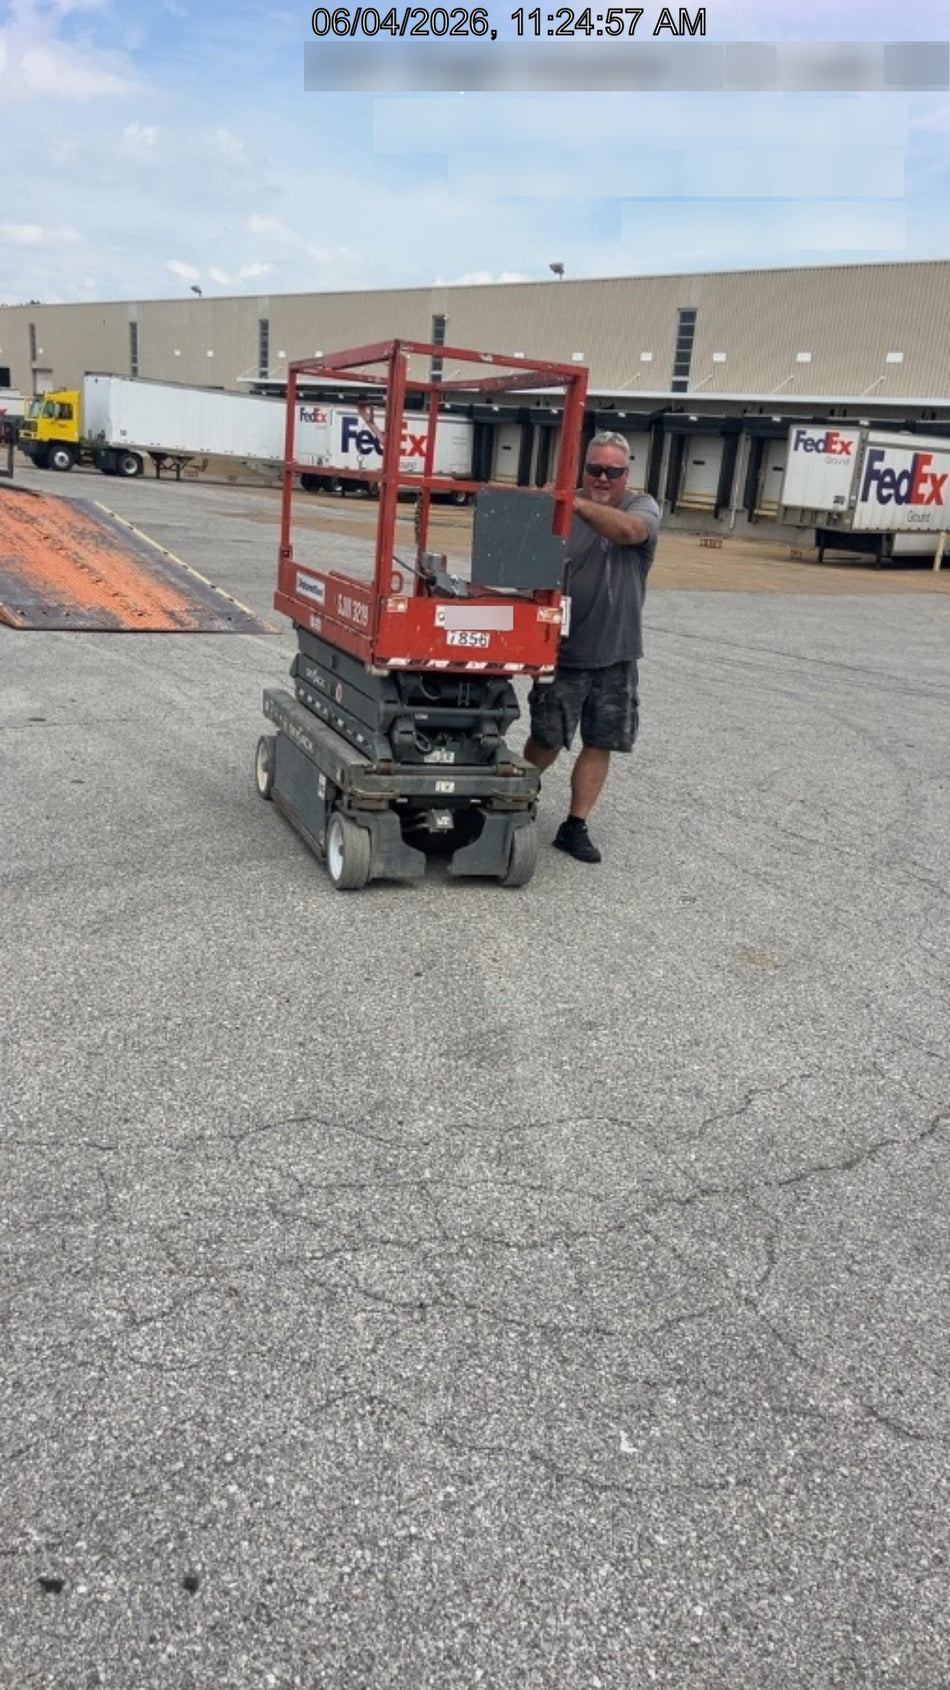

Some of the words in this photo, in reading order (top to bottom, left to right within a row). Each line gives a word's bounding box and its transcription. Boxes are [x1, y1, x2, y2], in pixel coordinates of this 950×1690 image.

[300, 407, 327, 423] FedEx
[793, 430, 853, 455] FedEx
[860, 448, 949, 506] FedEx
[905, 510, 931, 523] Ground
[449, 631, 488, 647] 7856
